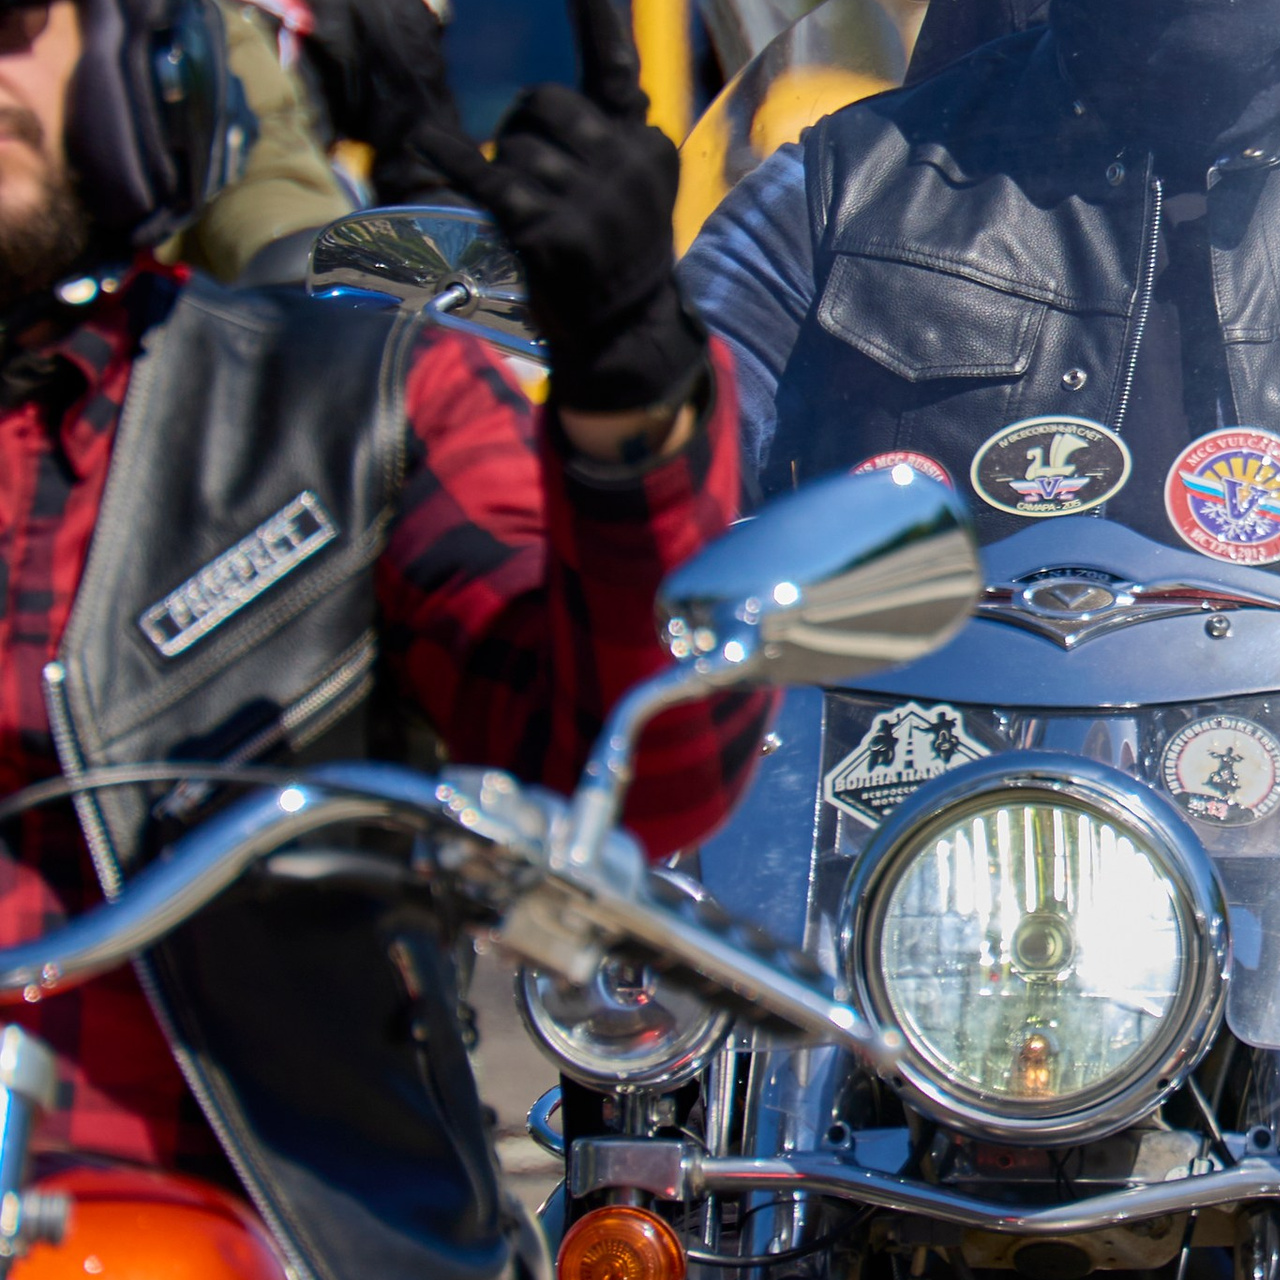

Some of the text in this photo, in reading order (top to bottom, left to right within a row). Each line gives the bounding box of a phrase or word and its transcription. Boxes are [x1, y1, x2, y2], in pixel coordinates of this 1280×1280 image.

[1186, 443, 1217, 467] MCC
[1220, 719, 1254, 735] BIKE
[835, 764, 946, 792] ВОЛНА ПАМ
[861, 786, 919, 800] ВСЕРОССИ
[871, 796, 904, 807] МОТО
